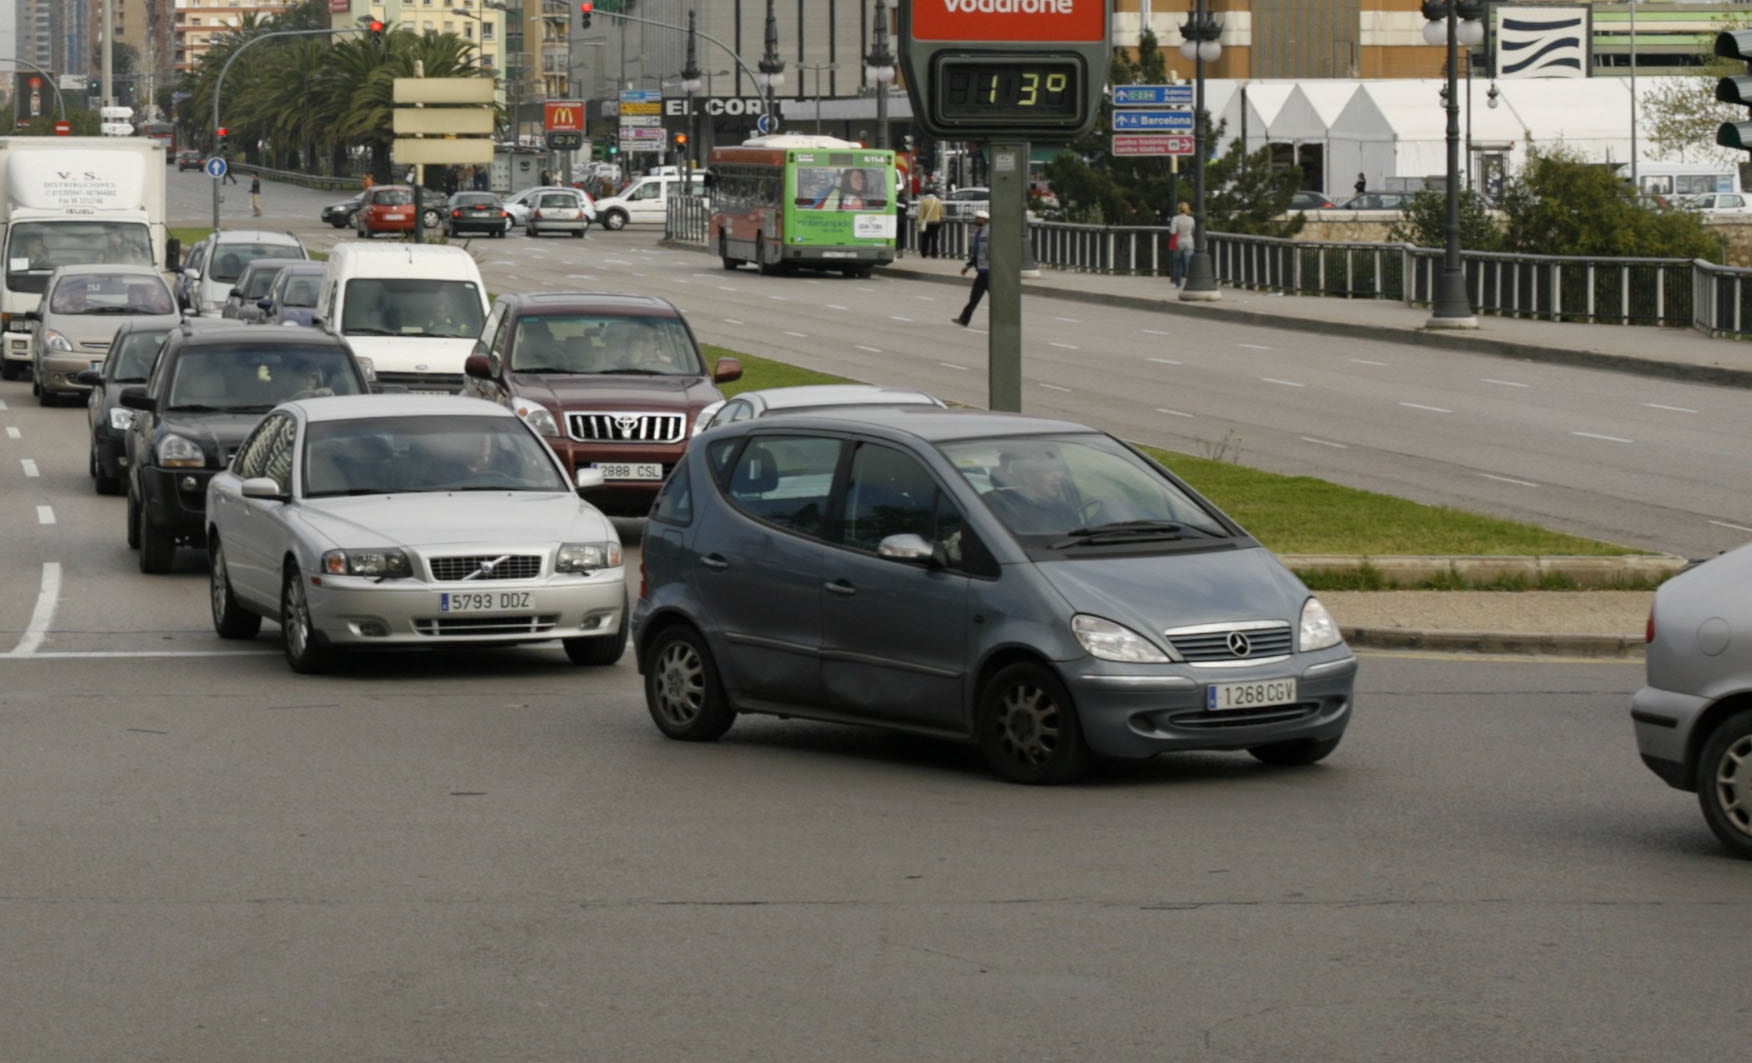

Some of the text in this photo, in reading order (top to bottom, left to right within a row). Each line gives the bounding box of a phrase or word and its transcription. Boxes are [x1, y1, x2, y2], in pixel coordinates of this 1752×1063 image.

[1141, 115, 1192, 126] Barcelona
[601, 465, 660, 477] 2888 CSL
[453, 593, 530, 610] 5793 DDZ
